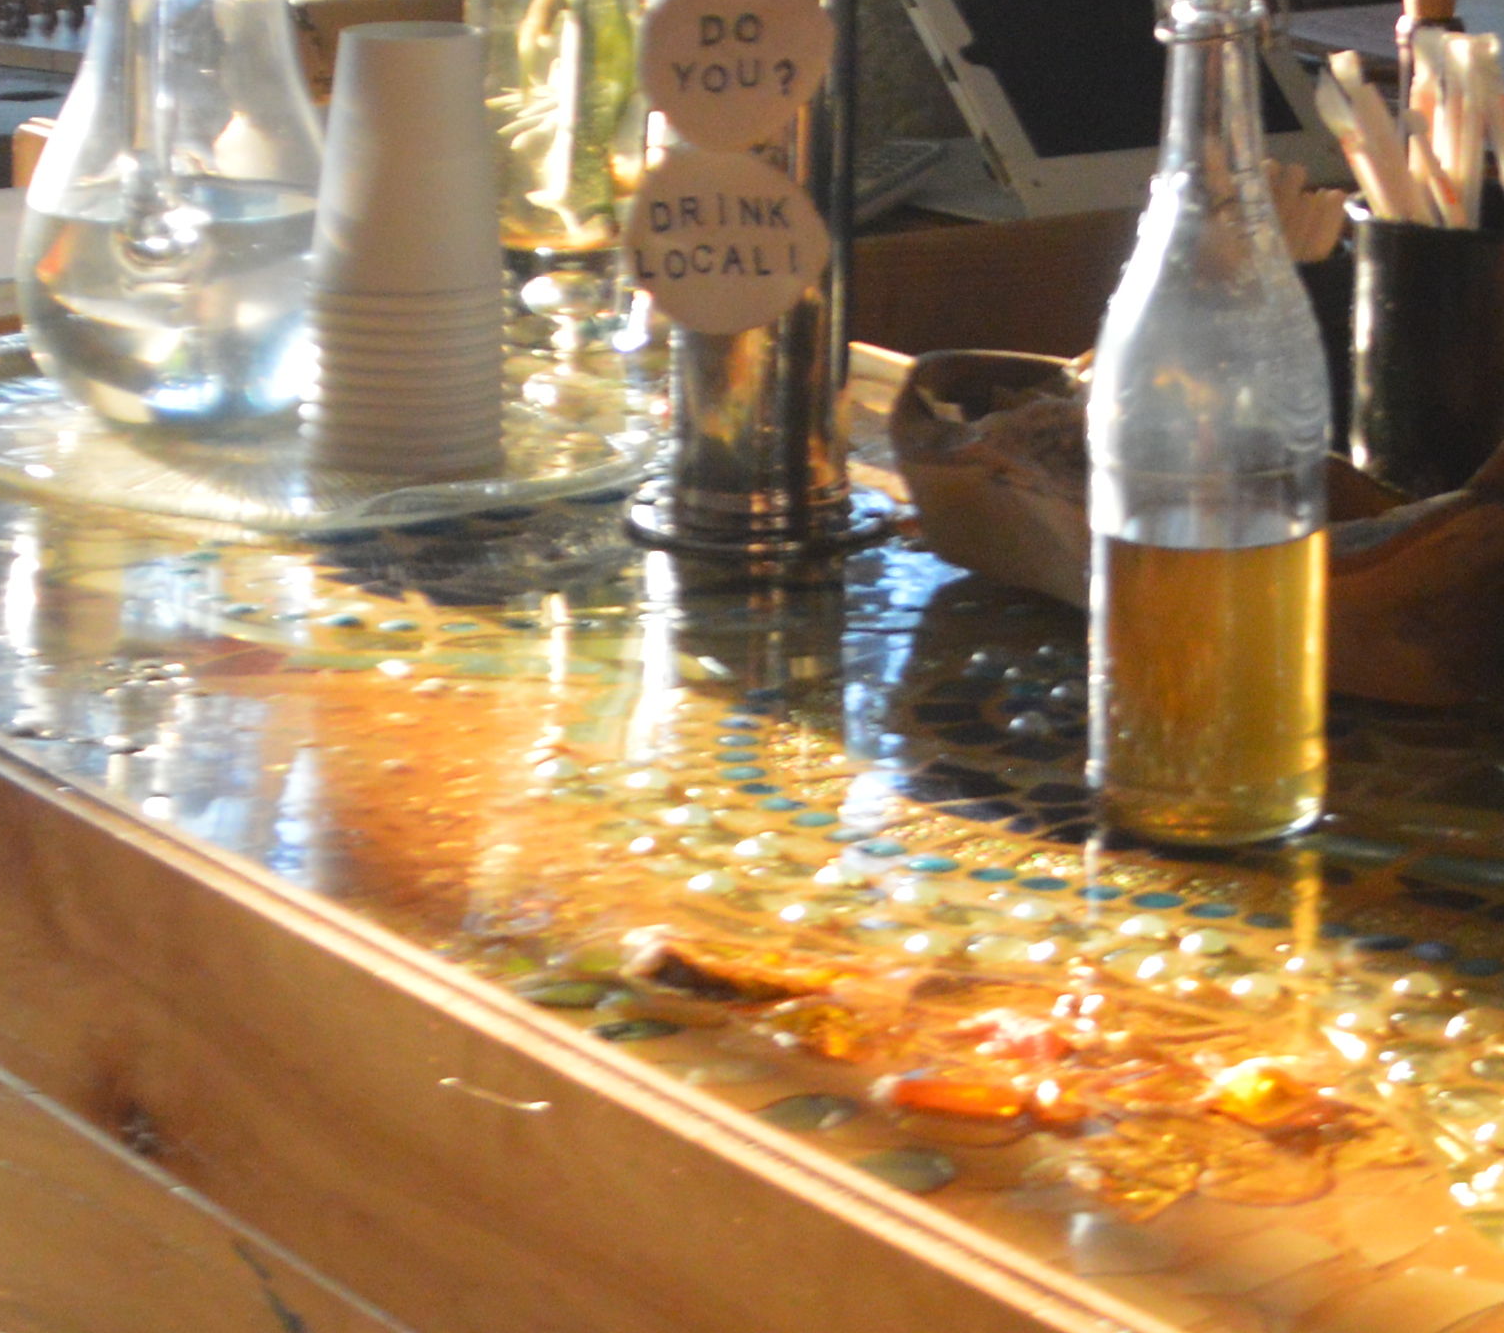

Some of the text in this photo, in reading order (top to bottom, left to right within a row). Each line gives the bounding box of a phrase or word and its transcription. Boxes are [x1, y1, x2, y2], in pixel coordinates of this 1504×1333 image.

[700, 12, 763, 47] DO
[671, 58, 796, 96] YOU?
[649, 194, 791, 233] DRINK
